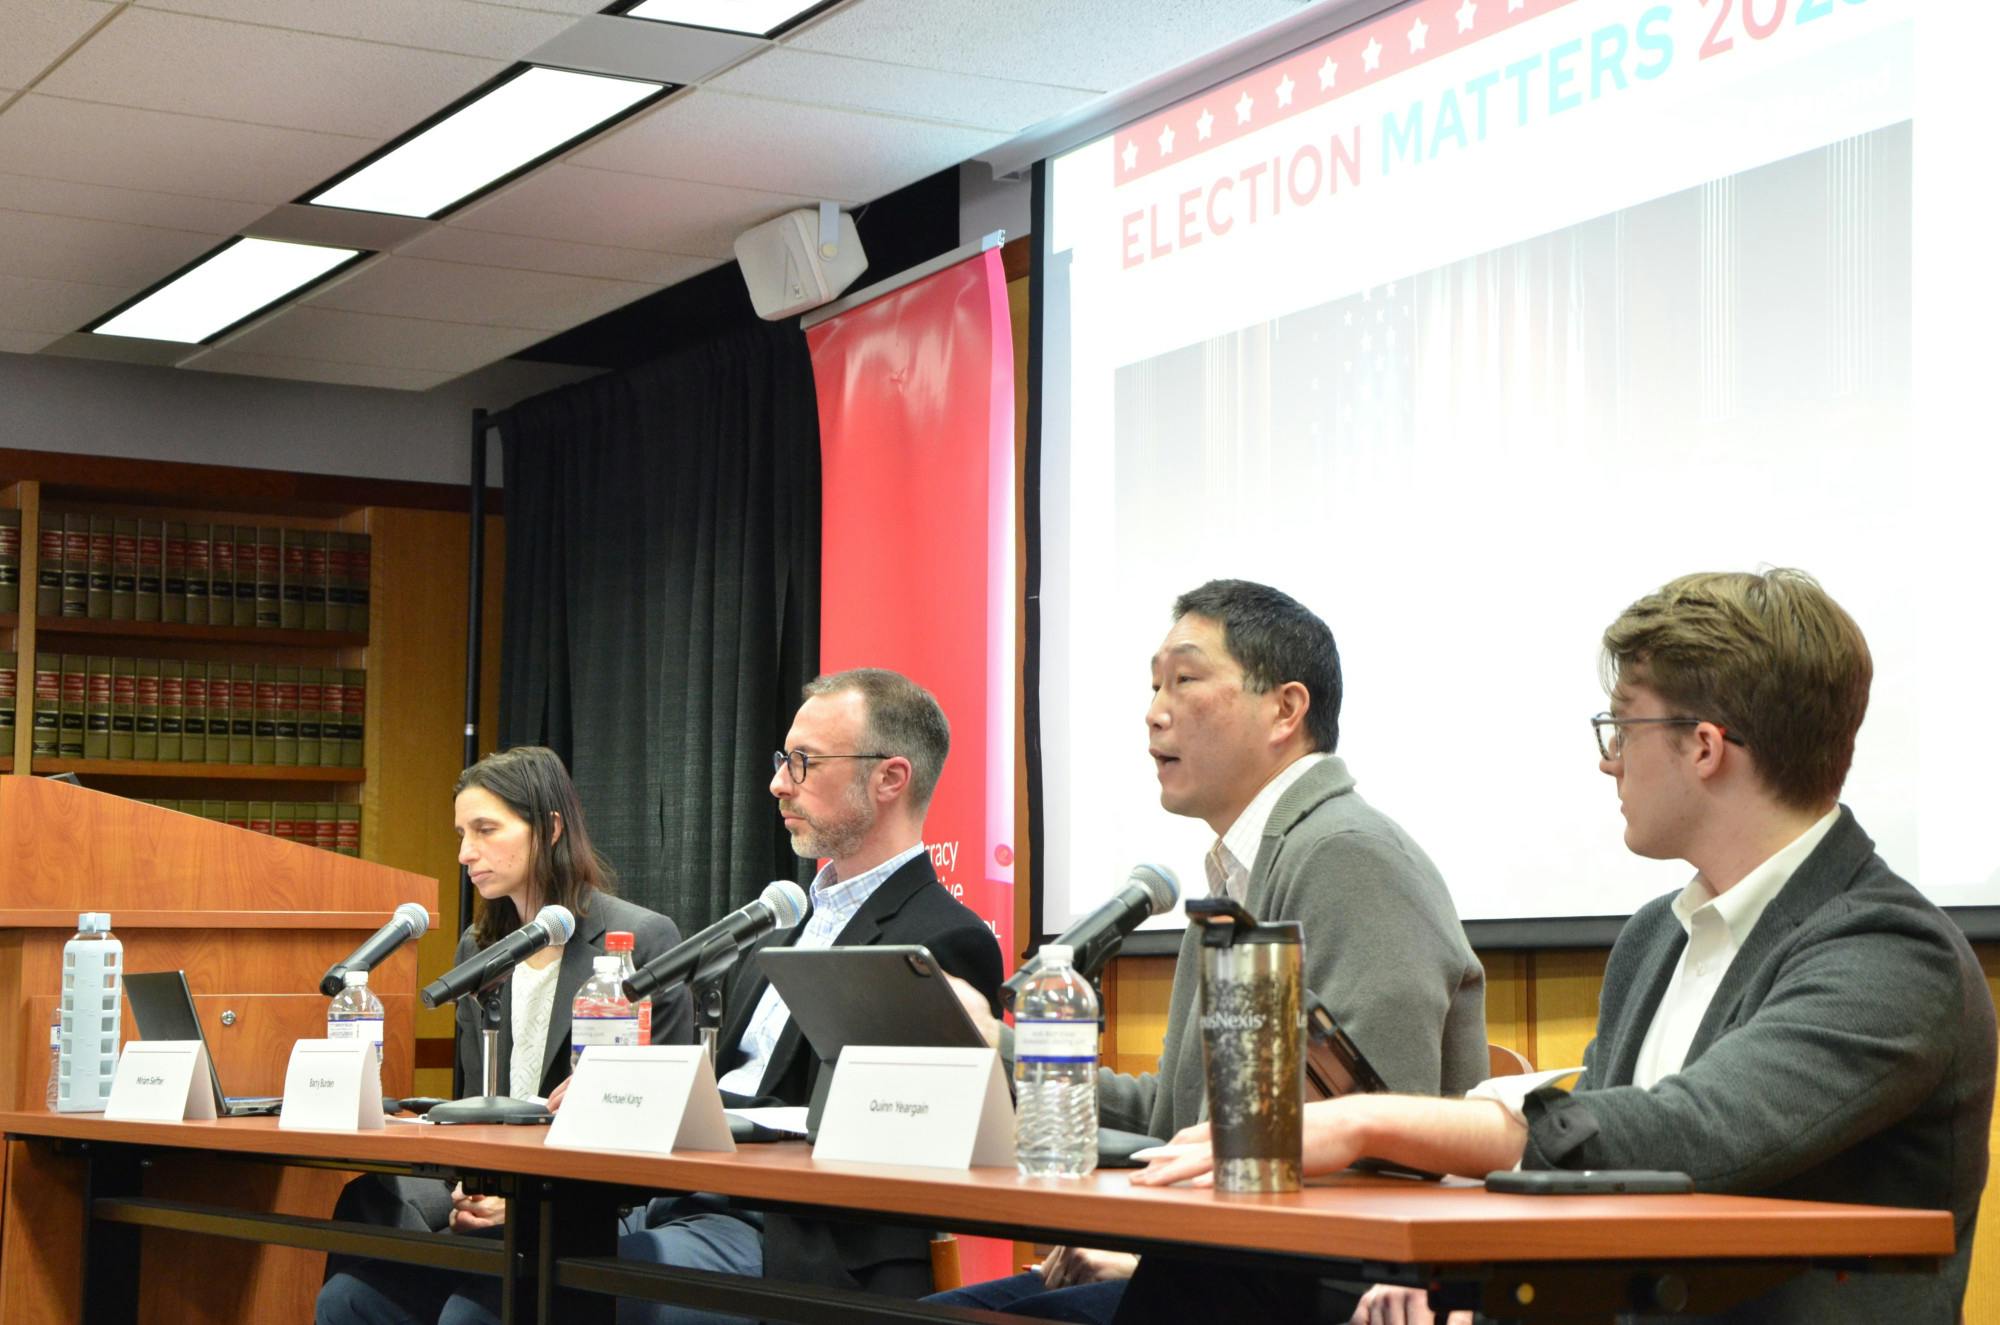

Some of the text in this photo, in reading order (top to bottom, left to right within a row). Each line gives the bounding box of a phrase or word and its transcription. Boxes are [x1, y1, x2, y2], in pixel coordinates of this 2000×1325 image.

[1122, 124, 1361, 270] ELECTION
[1381, 4, 1675, 176] MATTERS
[869, 1098, 929, 1118] Quinn Yeargain
